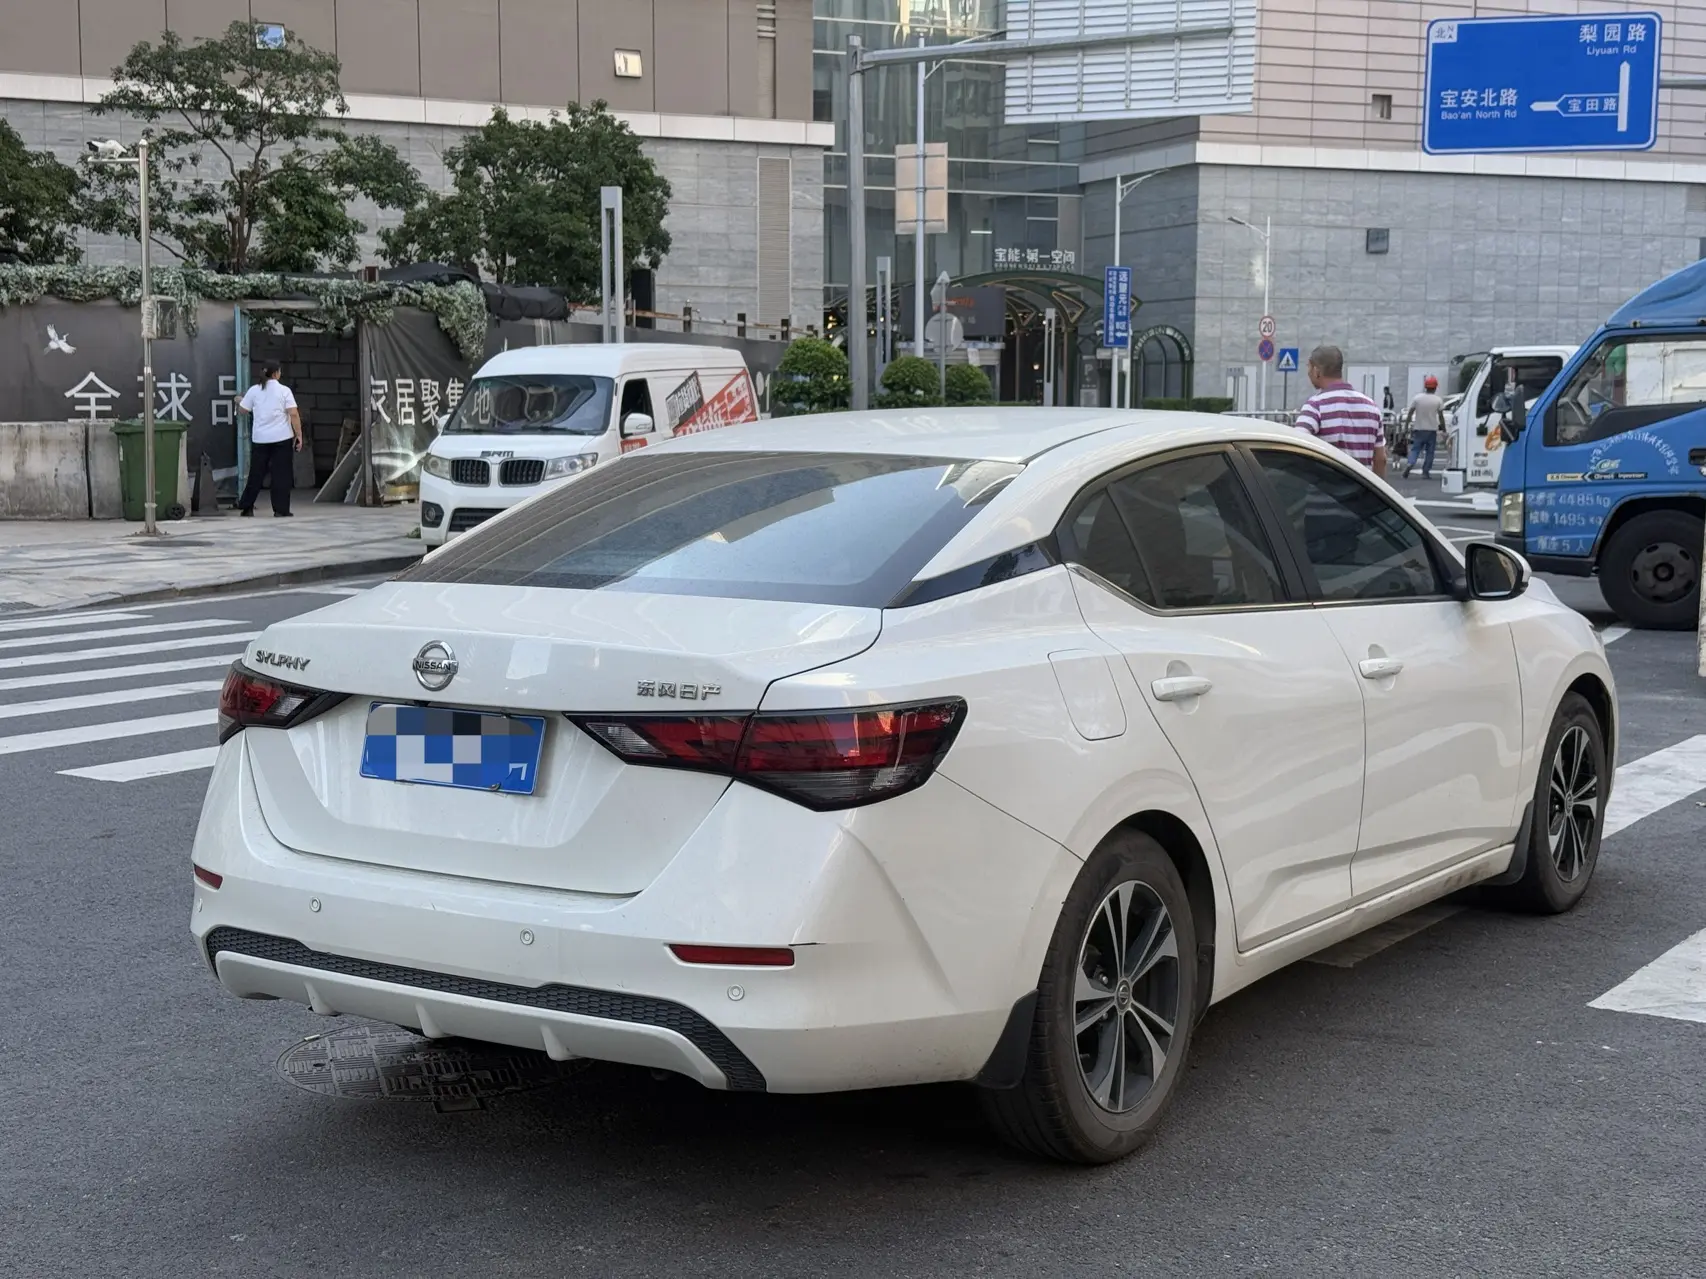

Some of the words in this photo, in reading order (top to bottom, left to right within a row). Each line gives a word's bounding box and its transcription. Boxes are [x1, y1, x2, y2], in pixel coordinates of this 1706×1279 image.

[1435, 27, 1446, 39] 北
[1579, 23, 1647, 43] 梨园路
[1587, 46, 1619, 56] Liyuan
[1623, 45, 1637, 54] Rd
[1440, 88, 1519, 108] 宝安北路
[1568, 97, 1617, 112] 宝田路
[1441, 110, 1472, 120] Bao'an
[1475, 109, 1500, 119] North
[1504, 109, 1517, 119] Rd
[1262, 321, 1273, 333] 20
[255, 650, 311, 671] SYLPHY
[414, 659, 452, 671] NISSAN
[637, 679, 721, 701] 东风日产
